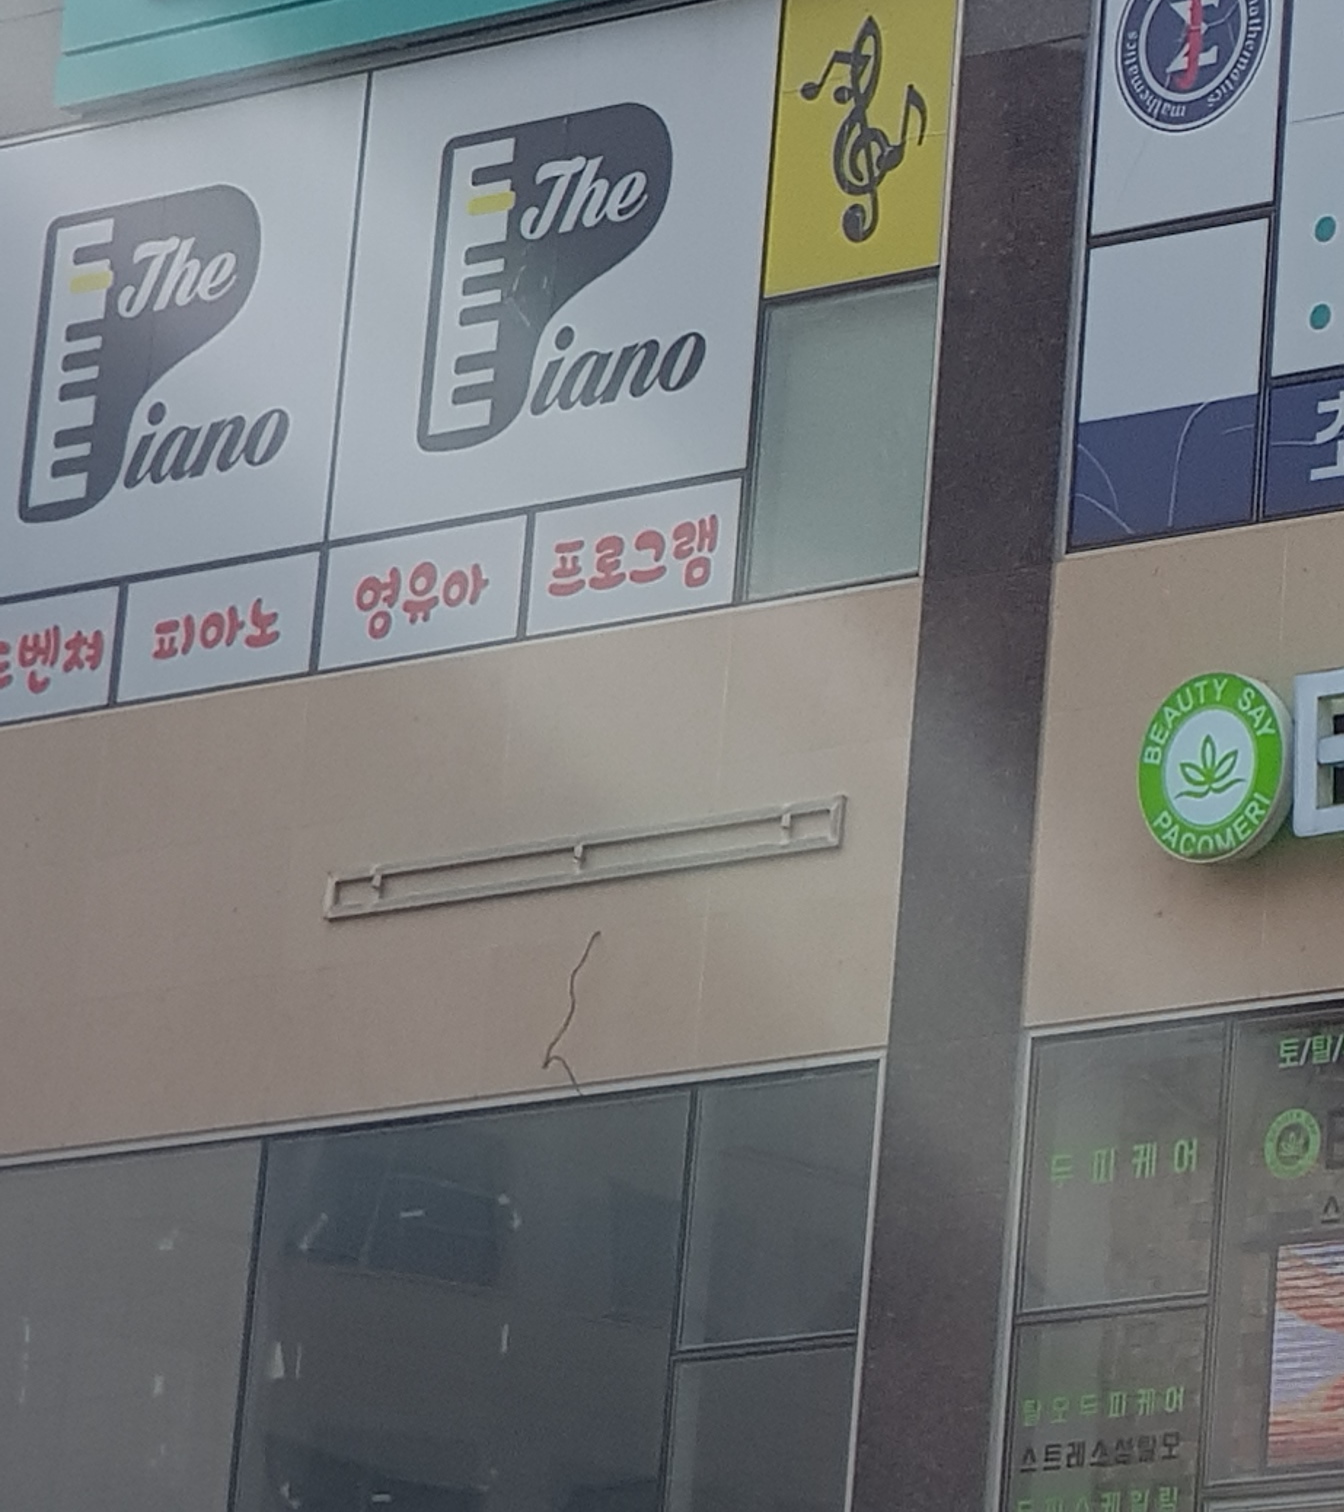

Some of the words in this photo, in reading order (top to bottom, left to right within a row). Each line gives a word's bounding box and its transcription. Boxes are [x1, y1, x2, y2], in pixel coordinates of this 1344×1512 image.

[520, 156, 648, 241] The
[118, 234, 238, 320] The
[152, 599, 282, 661] 피아노
[355, 561, 490, 641] 영유아
[547, 514, 721, 597] 프로그램
[1143, 678, 1228, 764] BEAUTY
[1238, 687, 1276, 736] SAY
[1152, 792, 1271, 855] PACOMERI
